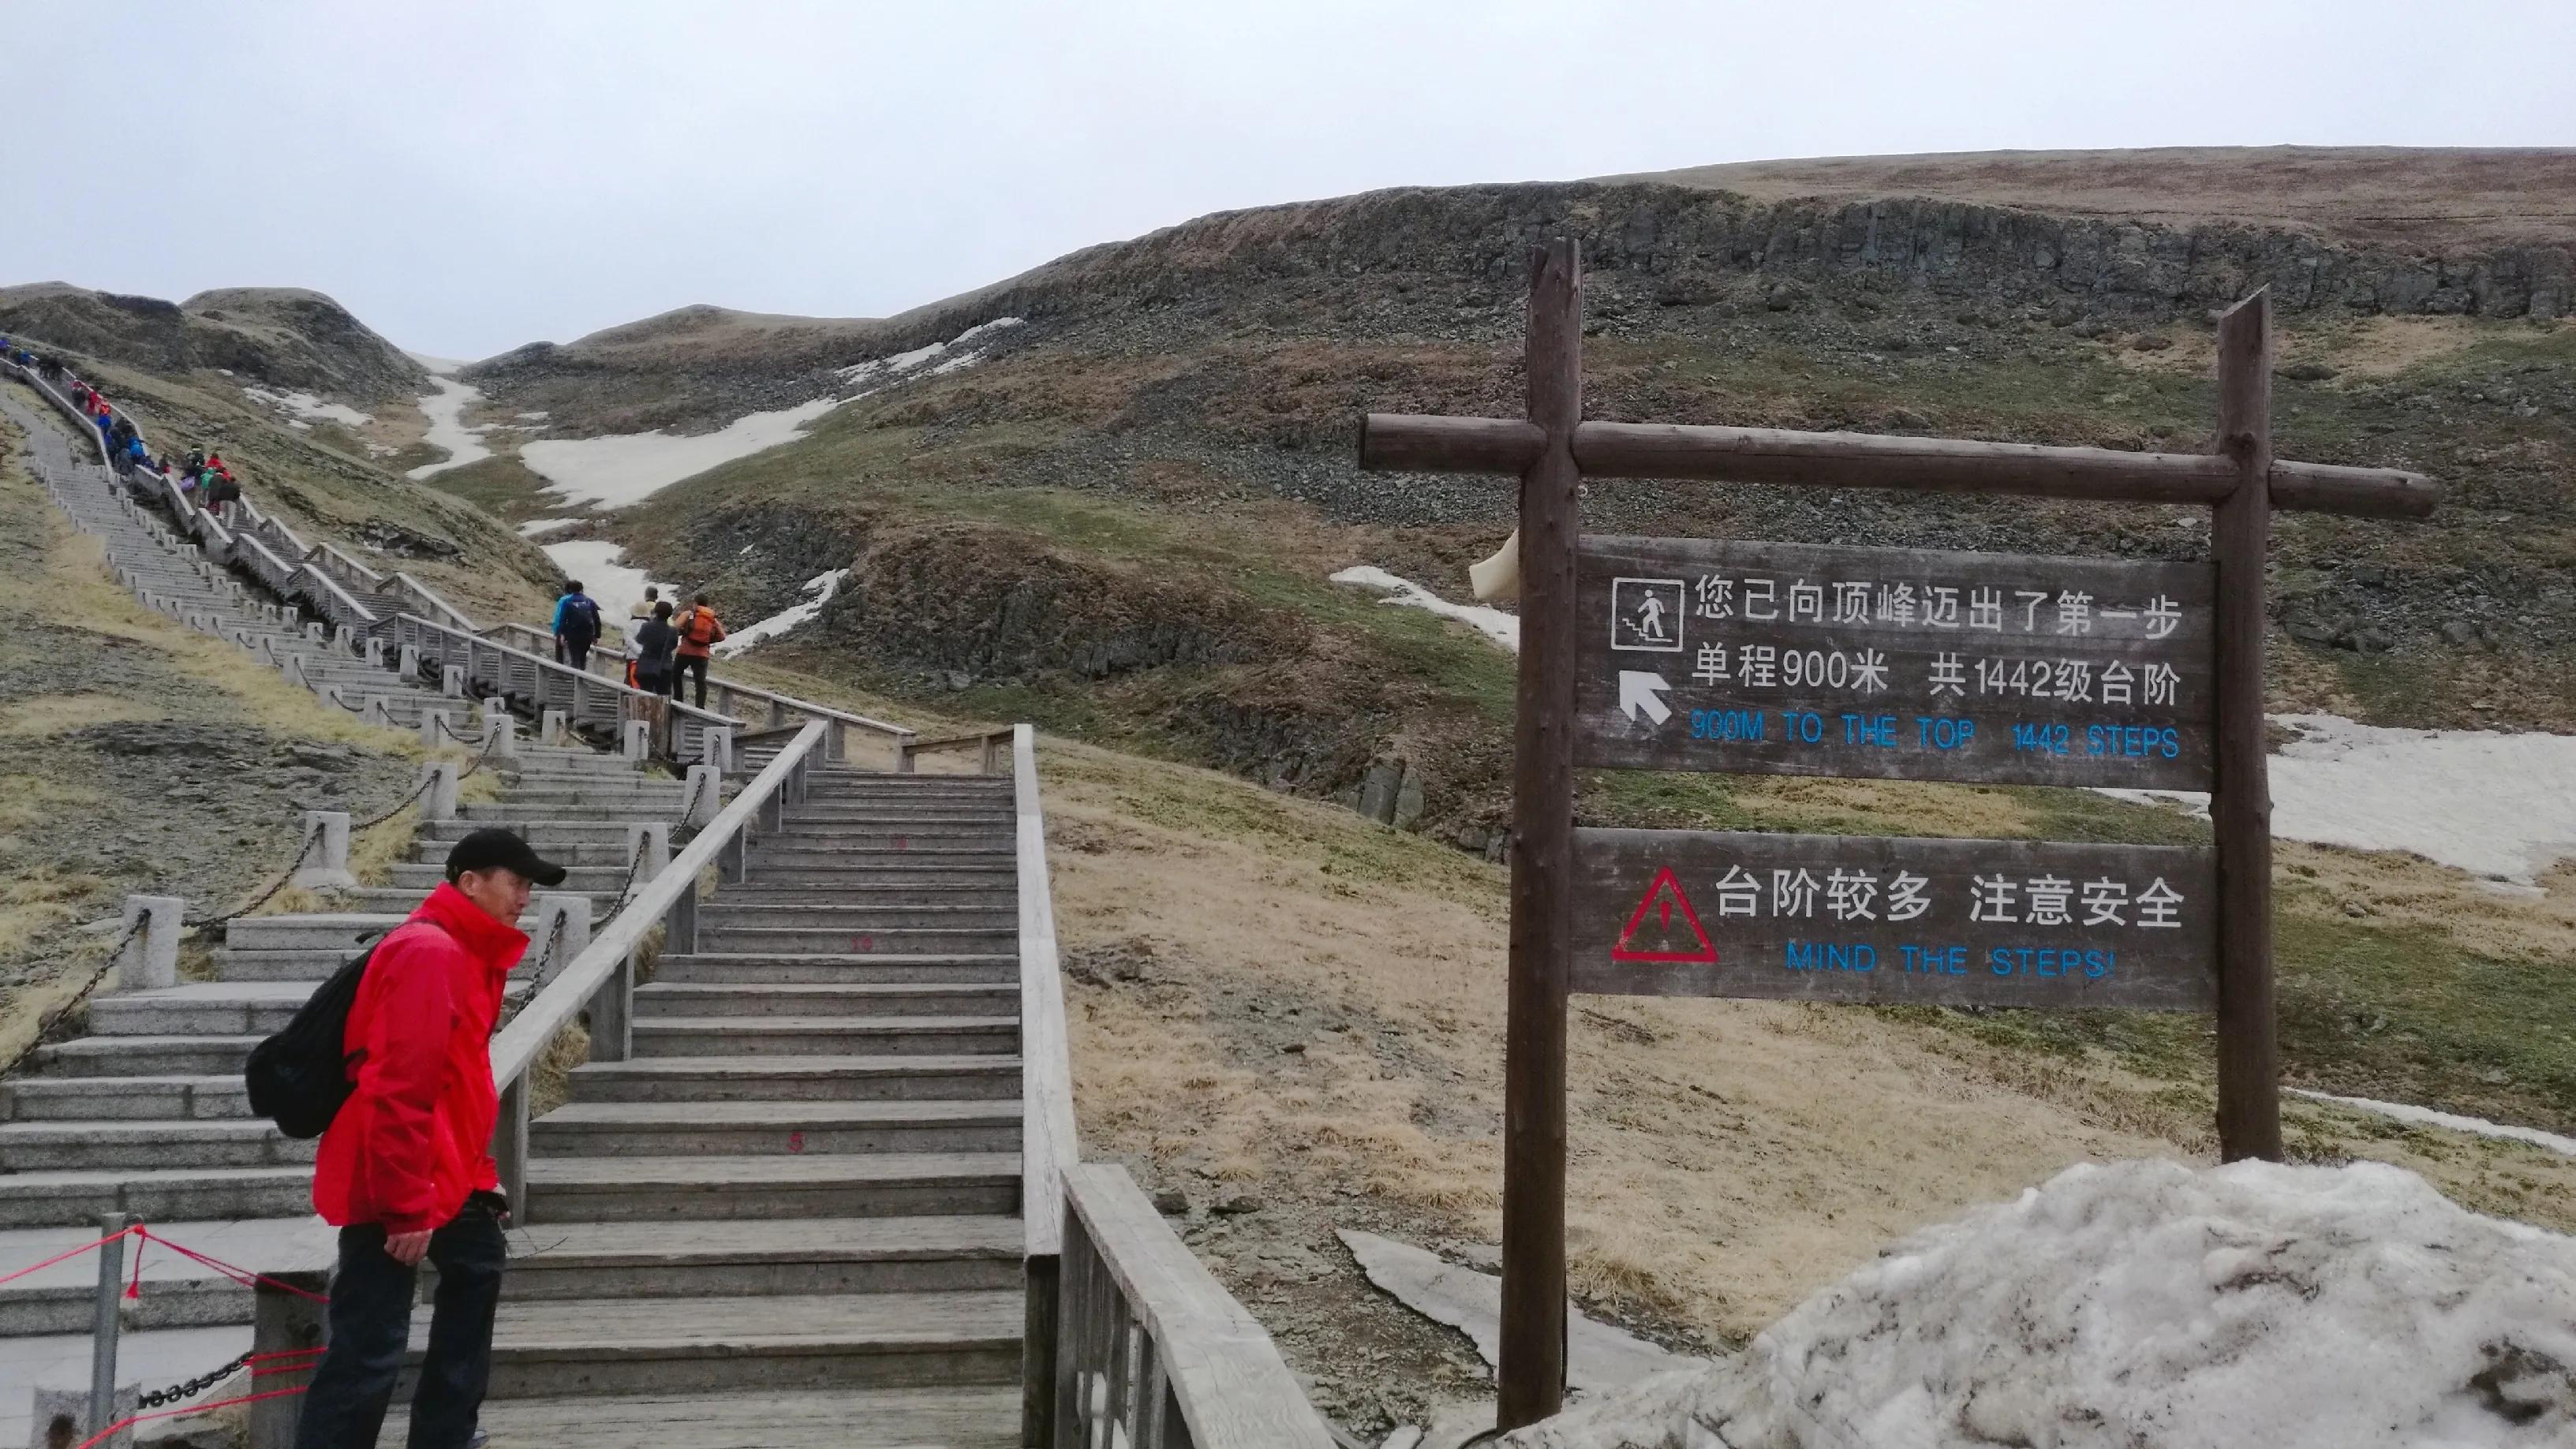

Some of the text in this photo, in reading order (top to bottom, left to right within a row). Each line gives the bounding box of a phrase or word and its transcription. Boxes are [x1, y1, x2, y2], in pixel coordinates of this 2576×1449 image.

[1694, 573, 2183, 640] 您已向顶峰迈出了第一步
[1692, 640, 2182, 706] 单程900米 共1442级台阶
[1691, 708, 2180, 760] 900M TO THE TOP 1442 STEPS
[1714, 864, 2185, 928] 台阶较多 注意安全
[1785, 942, 2115, 980] MIND THE STEPS!
